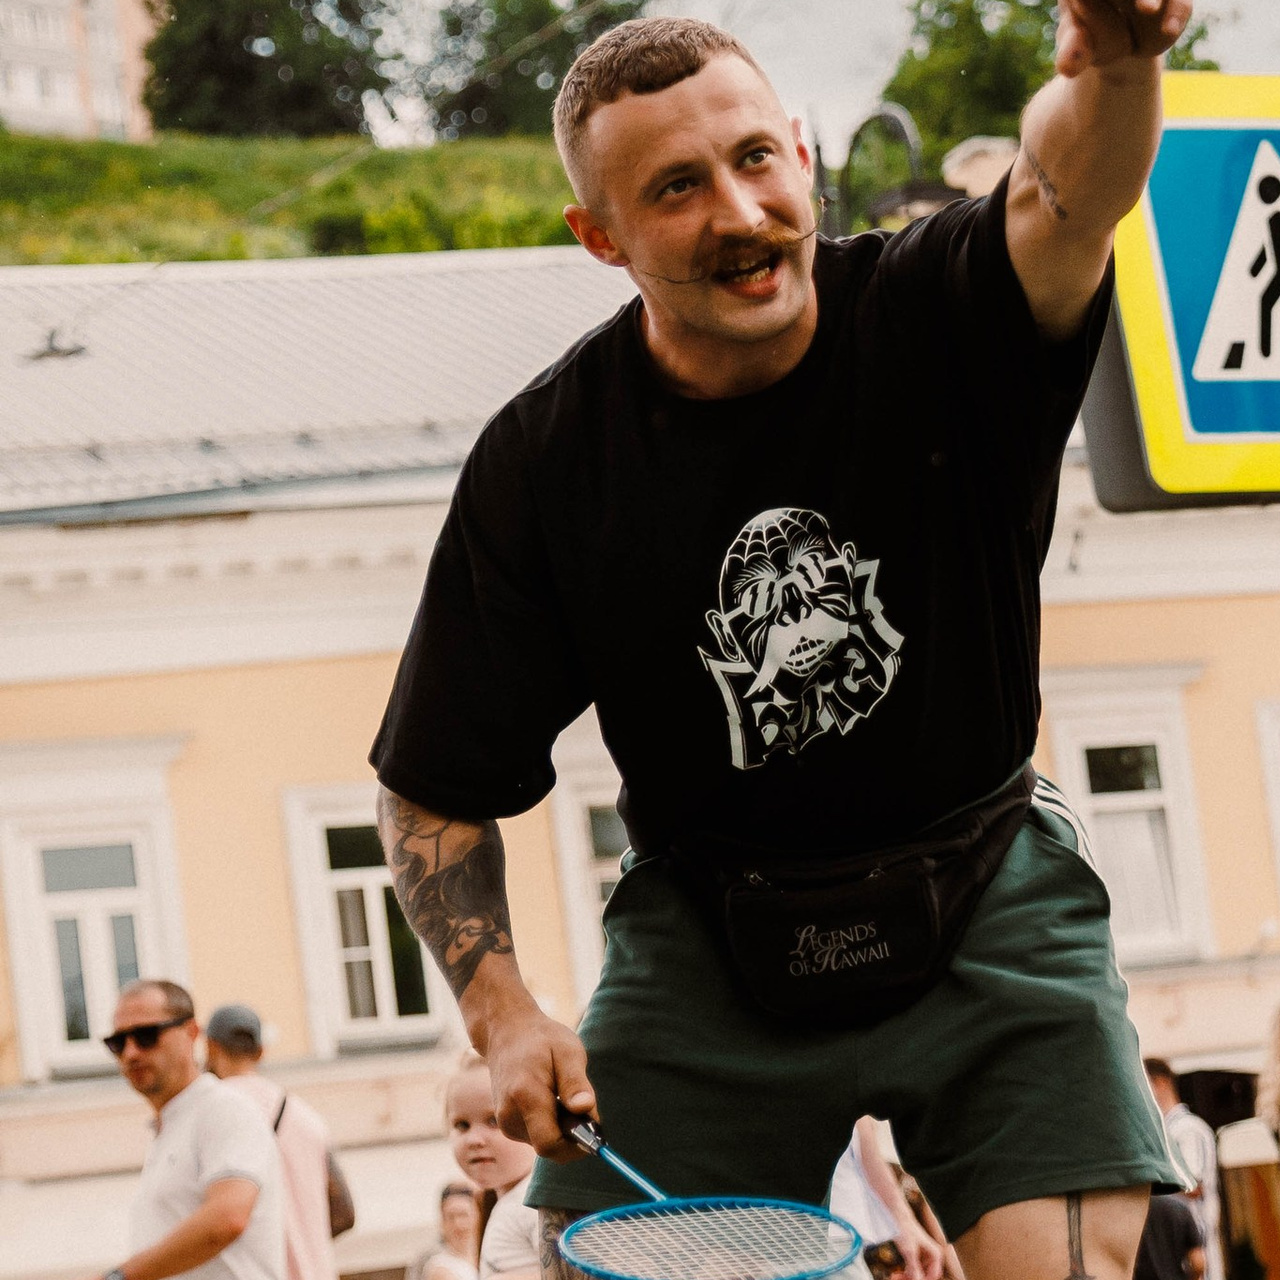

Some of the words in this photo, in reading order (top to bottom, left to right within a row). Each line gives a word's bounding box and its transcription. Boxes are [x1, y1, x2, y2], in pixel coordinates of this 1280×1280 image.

[789, 921, 877, 958] LEGENDS
[789, 960, 812, 976] OF
[812, 942, 891, 973] HAWAII
